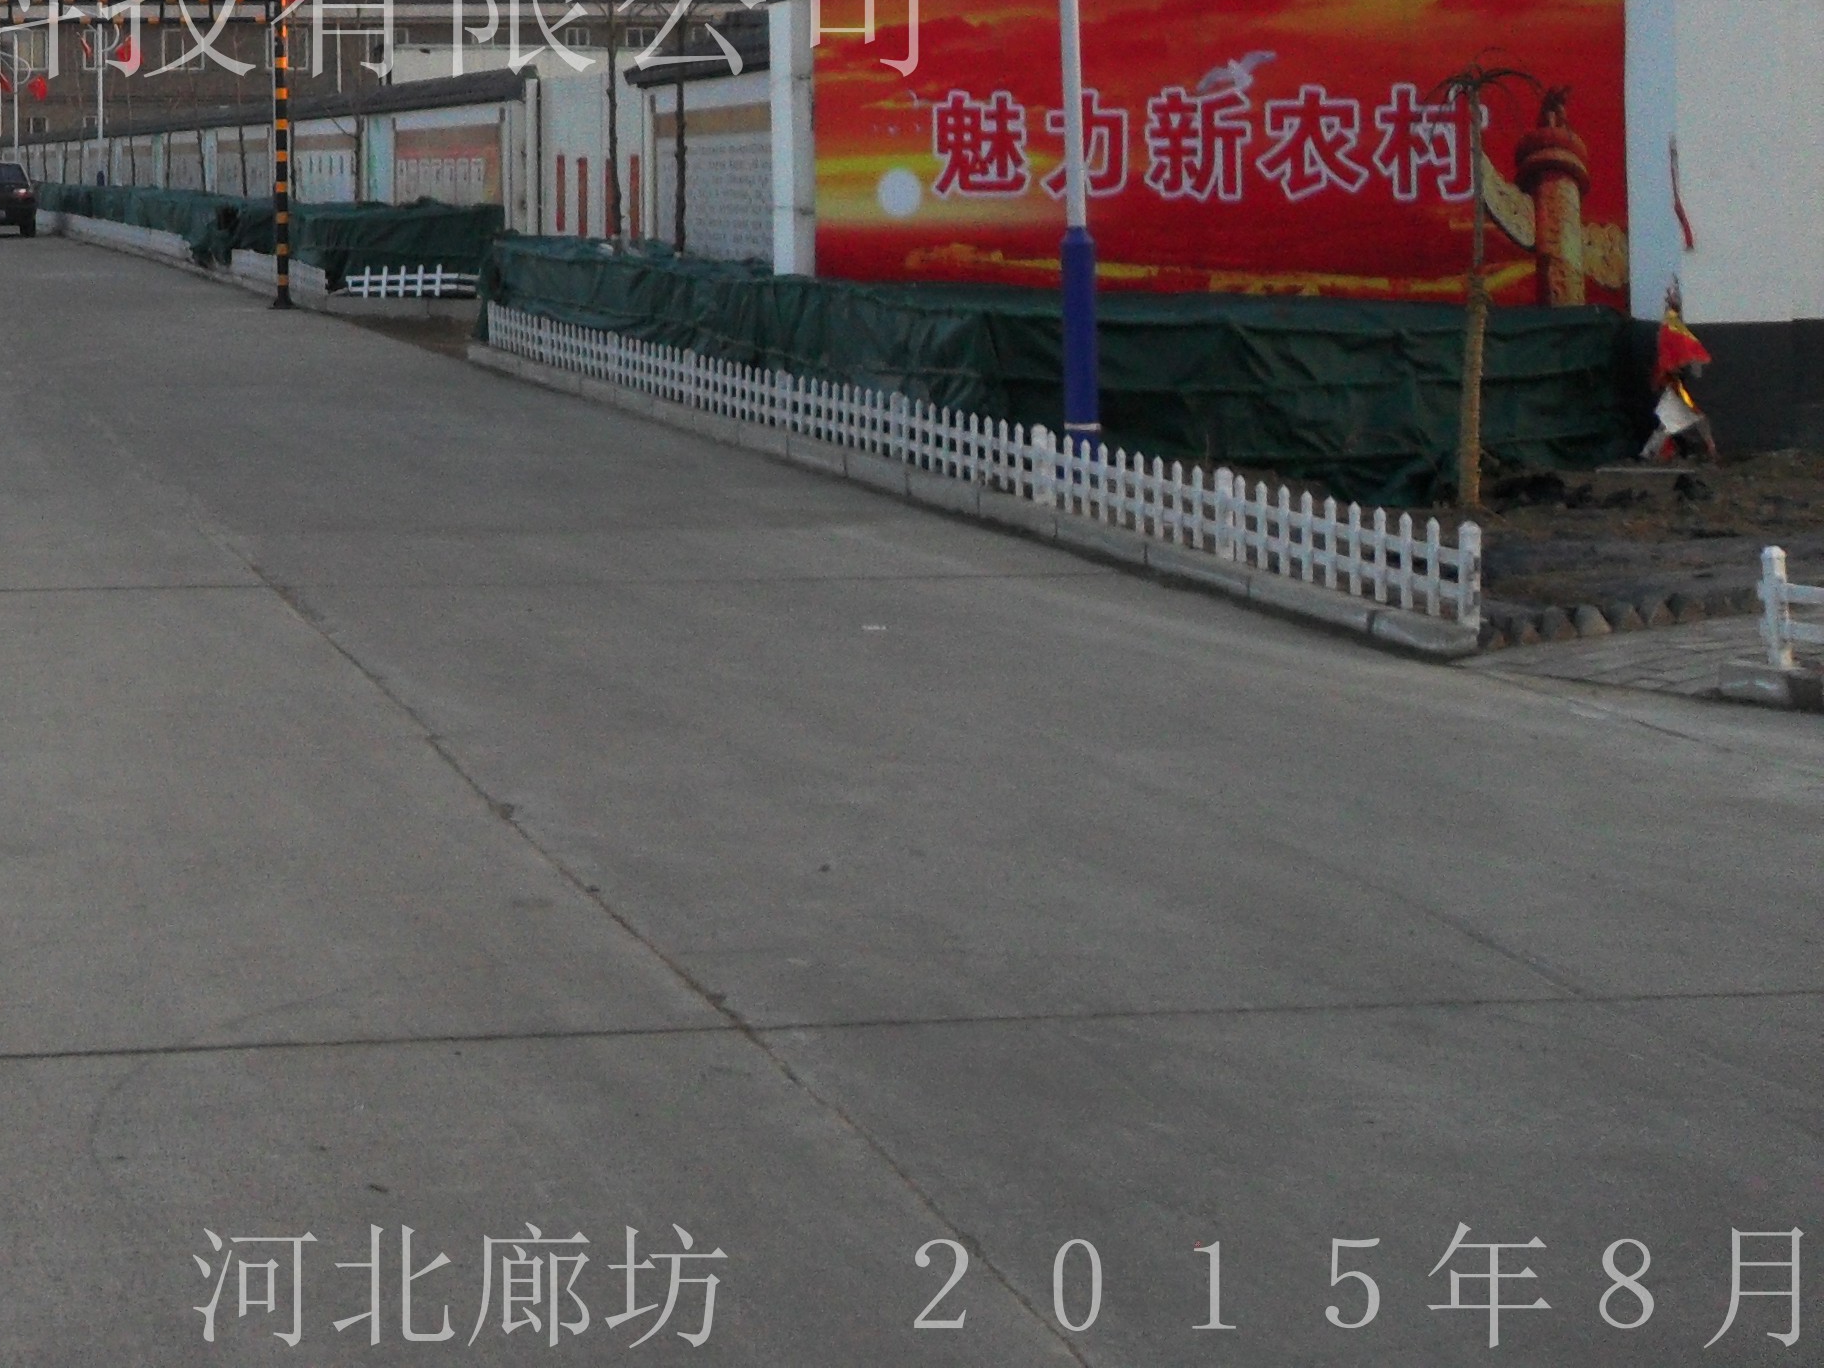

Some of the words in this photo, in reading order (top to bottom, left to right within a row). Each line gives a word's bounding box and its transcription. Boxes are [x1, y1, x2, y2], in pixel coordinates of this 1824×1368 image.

[930, 82, 1489, 203] 魅力新农村
